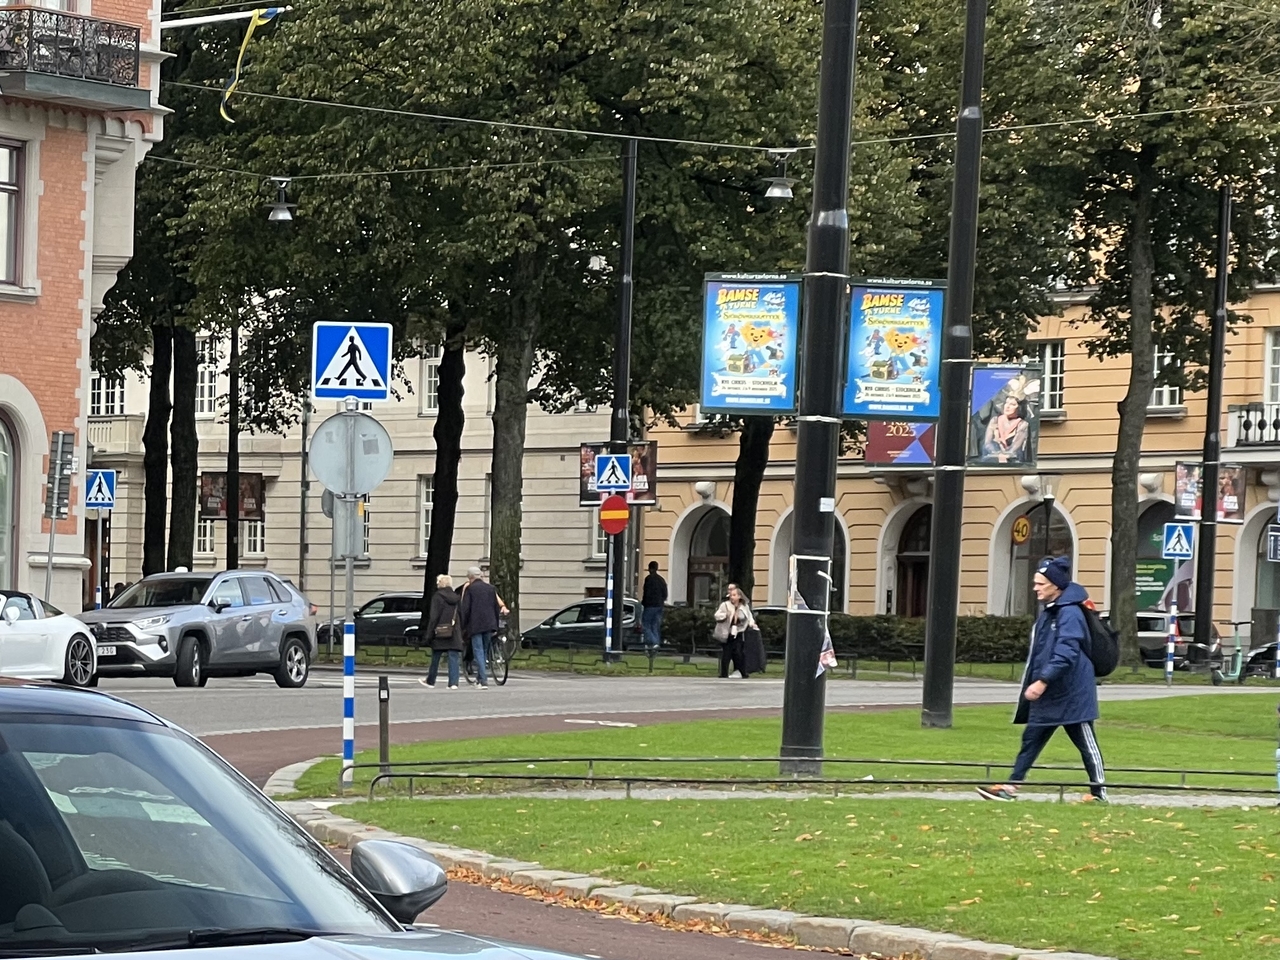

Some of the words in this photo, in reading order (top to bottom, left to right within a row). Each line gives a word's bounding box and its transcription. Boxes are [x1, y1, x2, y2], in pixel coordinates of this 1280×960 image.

[716, 288, 760, 306] BAMSE
[861, 293, 905, 311] BAMSE
[885, 424, 917, 437] 2025
[1014, 521, 1028, 538] 40
